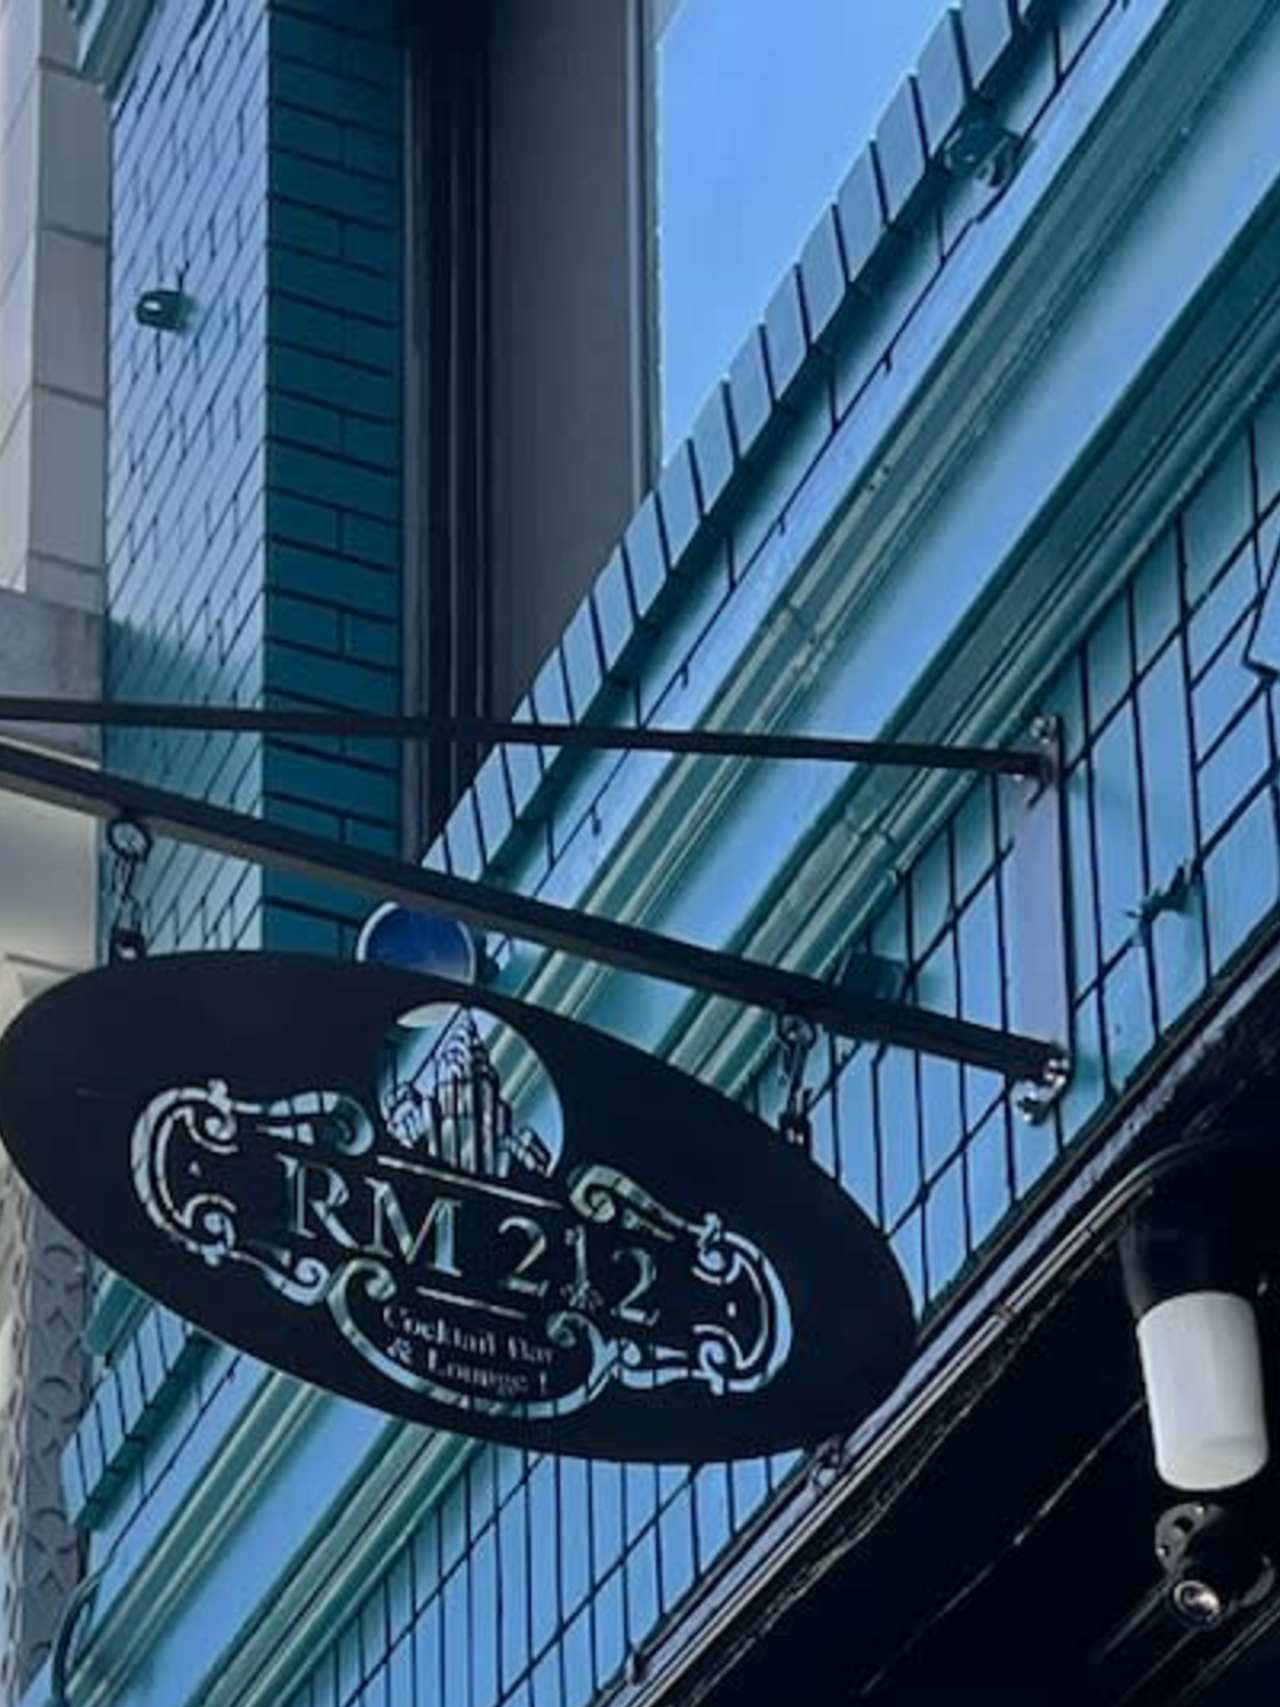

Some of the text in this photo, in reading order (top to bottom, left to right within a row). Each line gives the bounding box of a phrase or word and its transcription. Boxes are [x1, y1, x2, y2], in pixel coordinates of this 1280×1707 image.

[276, 1153, 661, 1327] RM 212
[382, 1305, 553, 1365] Cocktail Bar
[386, 1336, 413, 1365] &
[427, 1347, 529, 1398] Lounge
